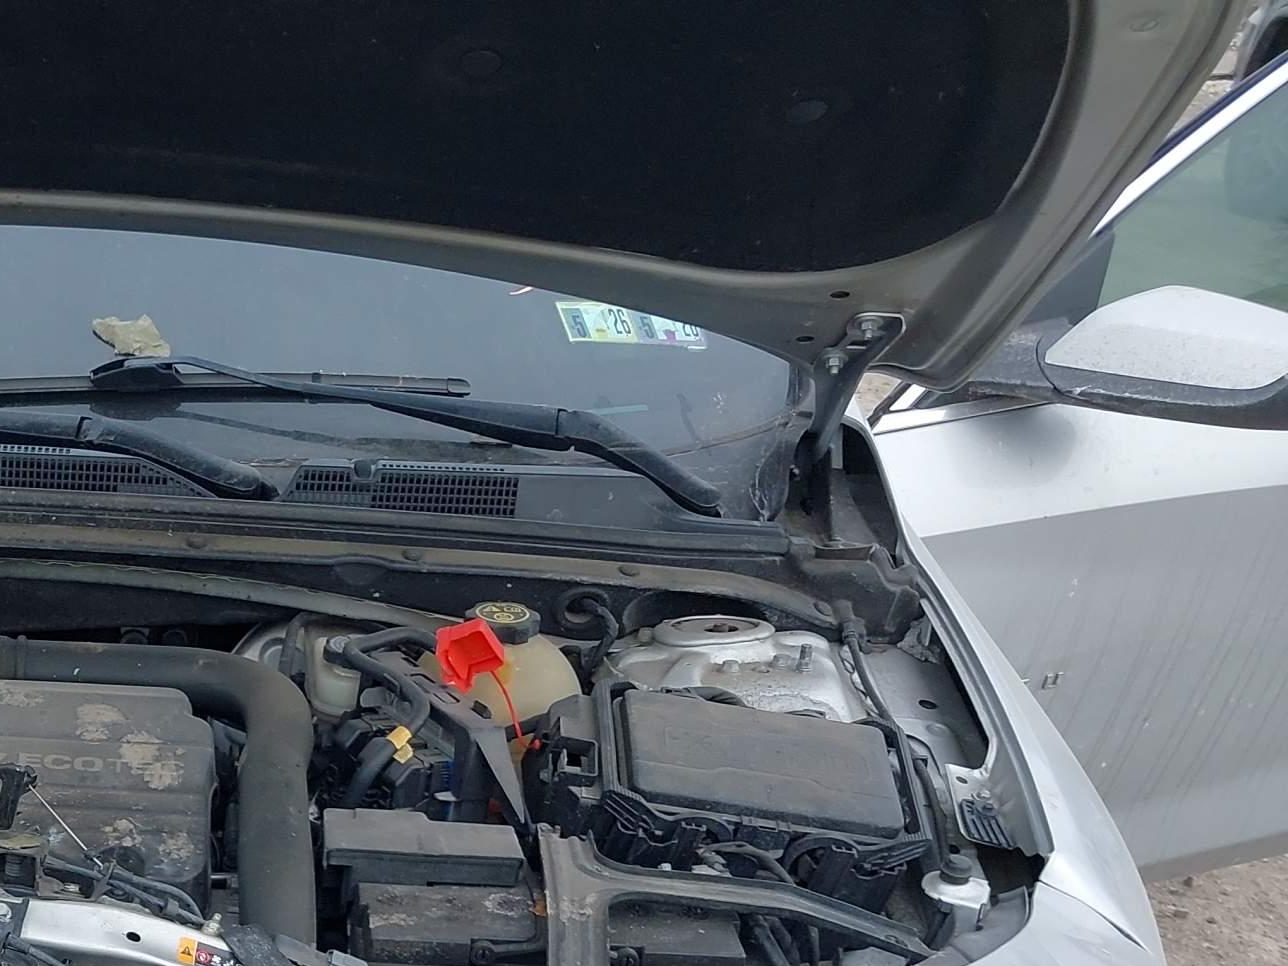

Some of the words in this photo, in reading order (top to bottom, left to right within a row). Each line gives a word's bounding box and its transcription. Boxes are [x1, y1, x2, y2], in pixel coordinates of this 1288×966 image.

[572, 315, 587, 338] 5
[608, 308, 632, 335] 26
[639, 316, 655, 339] 5
